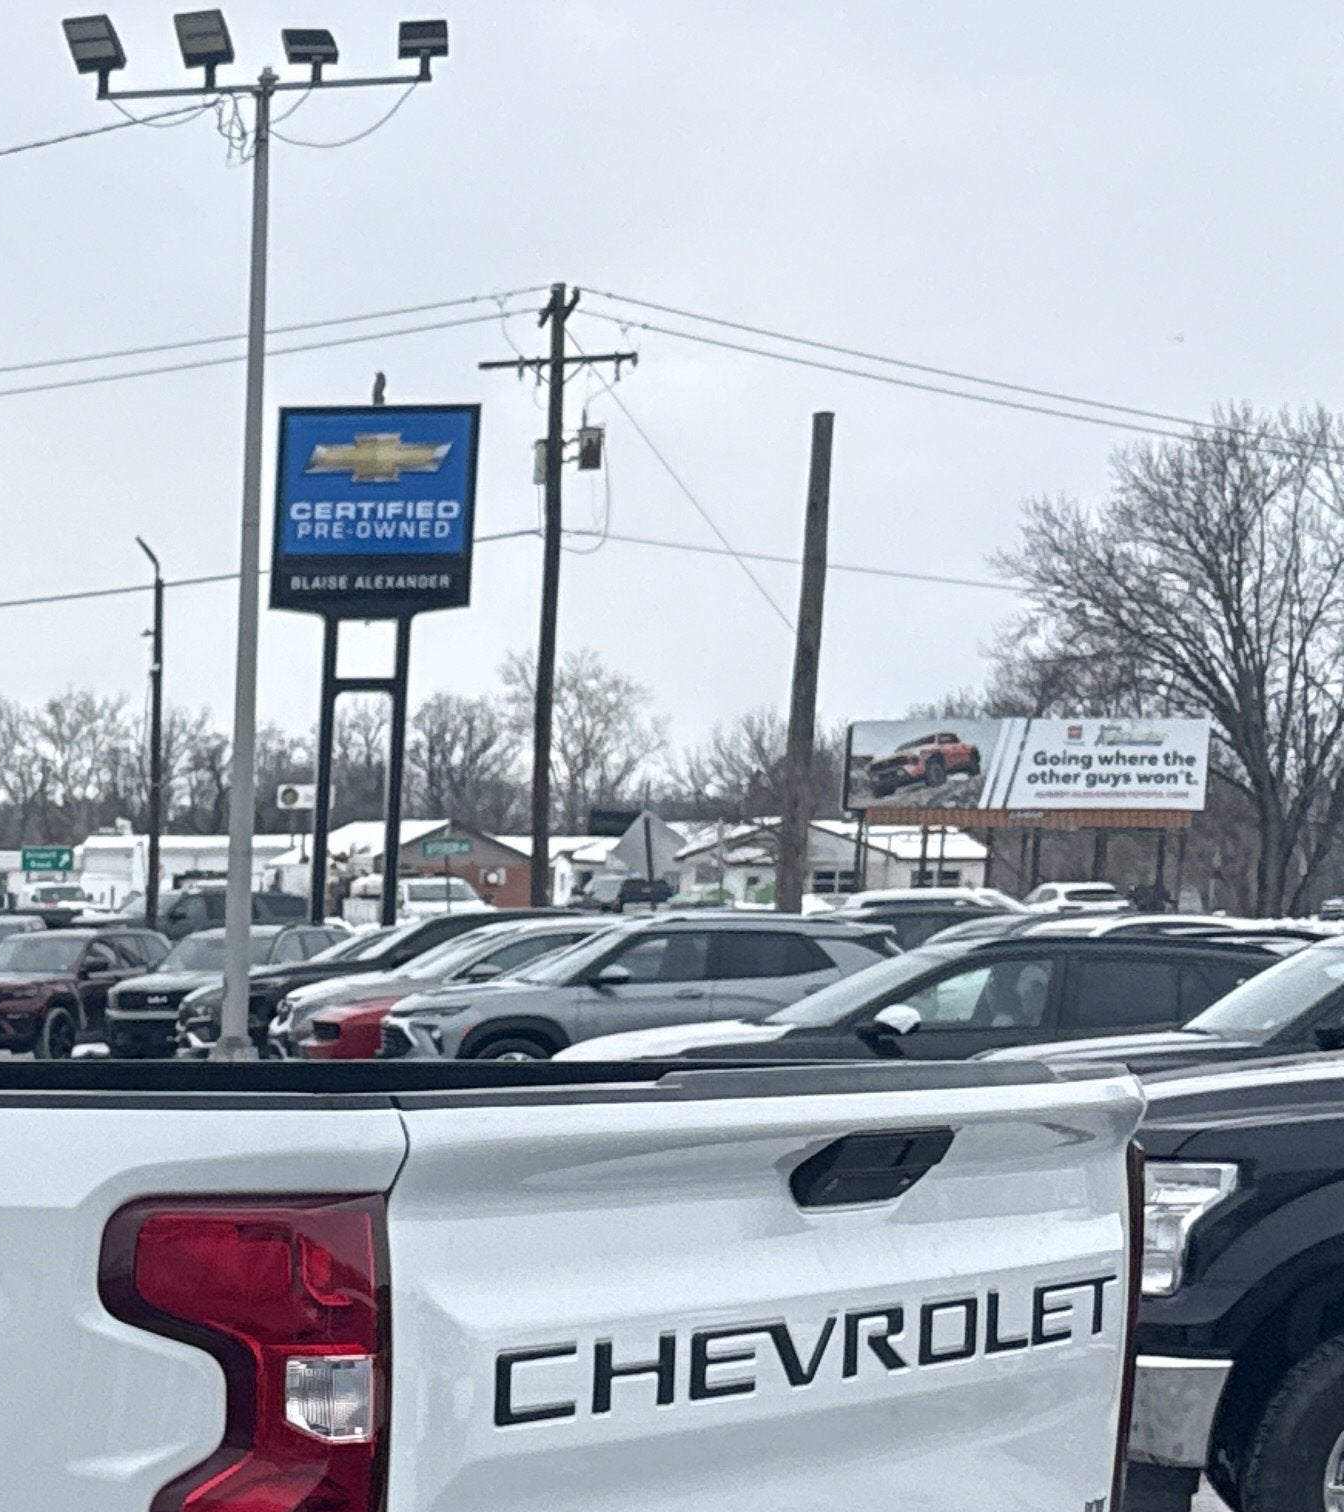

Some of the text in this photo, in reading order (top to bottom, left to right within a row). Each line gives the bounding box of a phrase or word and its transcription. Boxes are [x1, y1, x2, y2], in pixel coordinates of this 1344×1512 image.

[290, 501, 461, 520] CERTIFIED
[297, 521, 450, 539] PRE-OWNED
[290, 573, 450, 590] BLAISE ALEXANDER
[1033, 750, 1197, 770] Going where the
[1027, 769, 1081, 785] other
[1085, 773, 1132, 788] guys
[494, 1274, 1117, 1428] CHEVROLET
